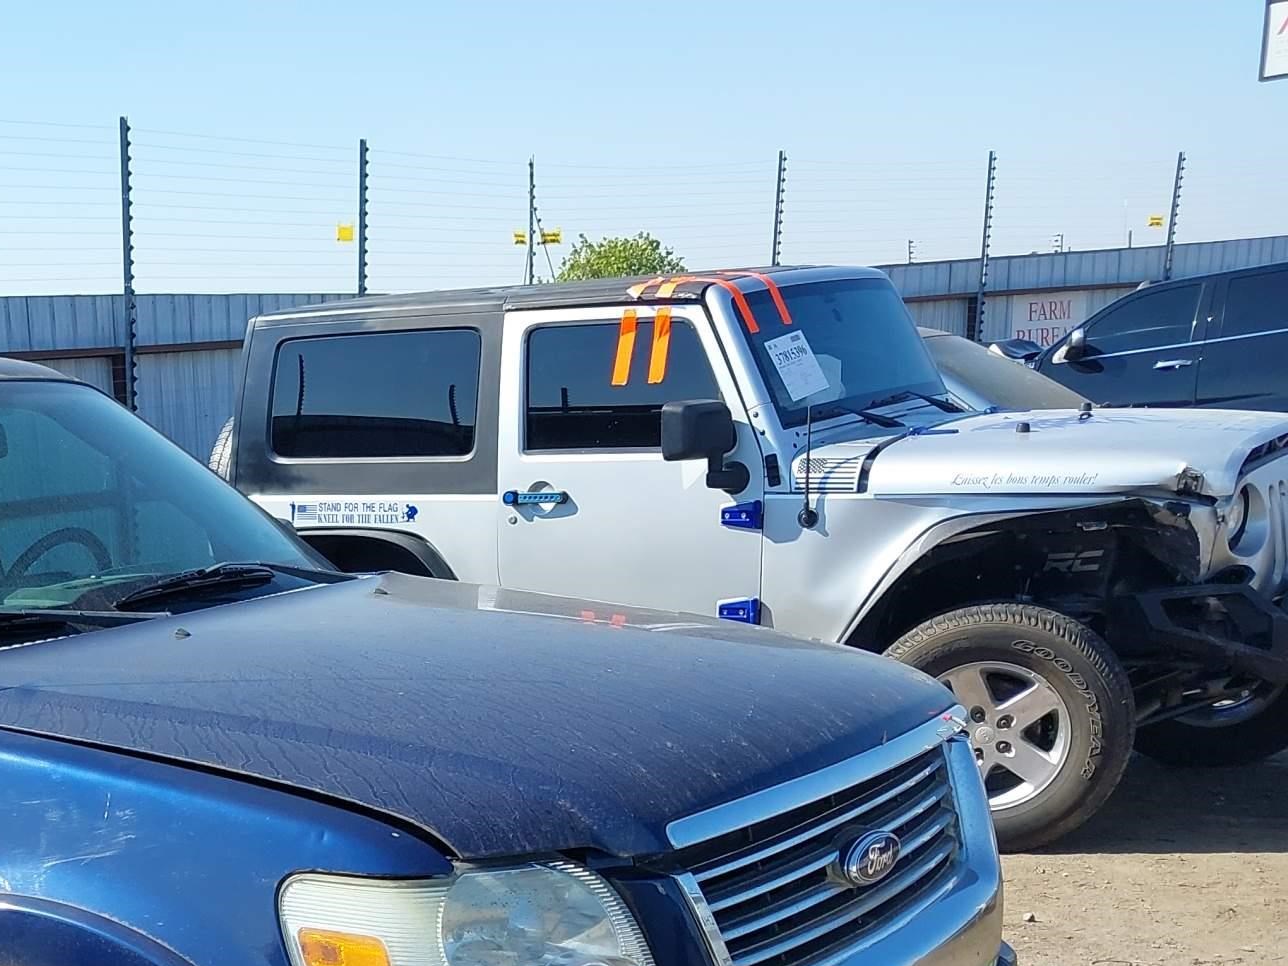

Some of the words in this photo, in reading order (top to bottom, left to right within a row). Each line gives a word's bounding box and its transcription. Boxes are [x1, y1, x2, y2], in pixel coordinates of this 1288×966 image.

[1027, 300, 1072, 321] FARM
[952, 473, 992, 489] Laissez
[990, 473, 1003, 485] les
[1006, 472, 1028, 485] bons
[1030, 474, 1059, 487] temps
[318, 502, 342, 512] STAND
[344, 502, 359, 512] FOR
[361, 502, 376, 512] THE
[378, 502, 399, 512] FLAG
[317, 513, 340, 524] KNEEL
[341, 513, 355, 524] FOR
[357, 513, 372, 524] THE
[374, 513, 399, 524] FALLEN
[1011, 638, 1104, 780] GOODYEAR
[866, 839, 895, 876] Ford
